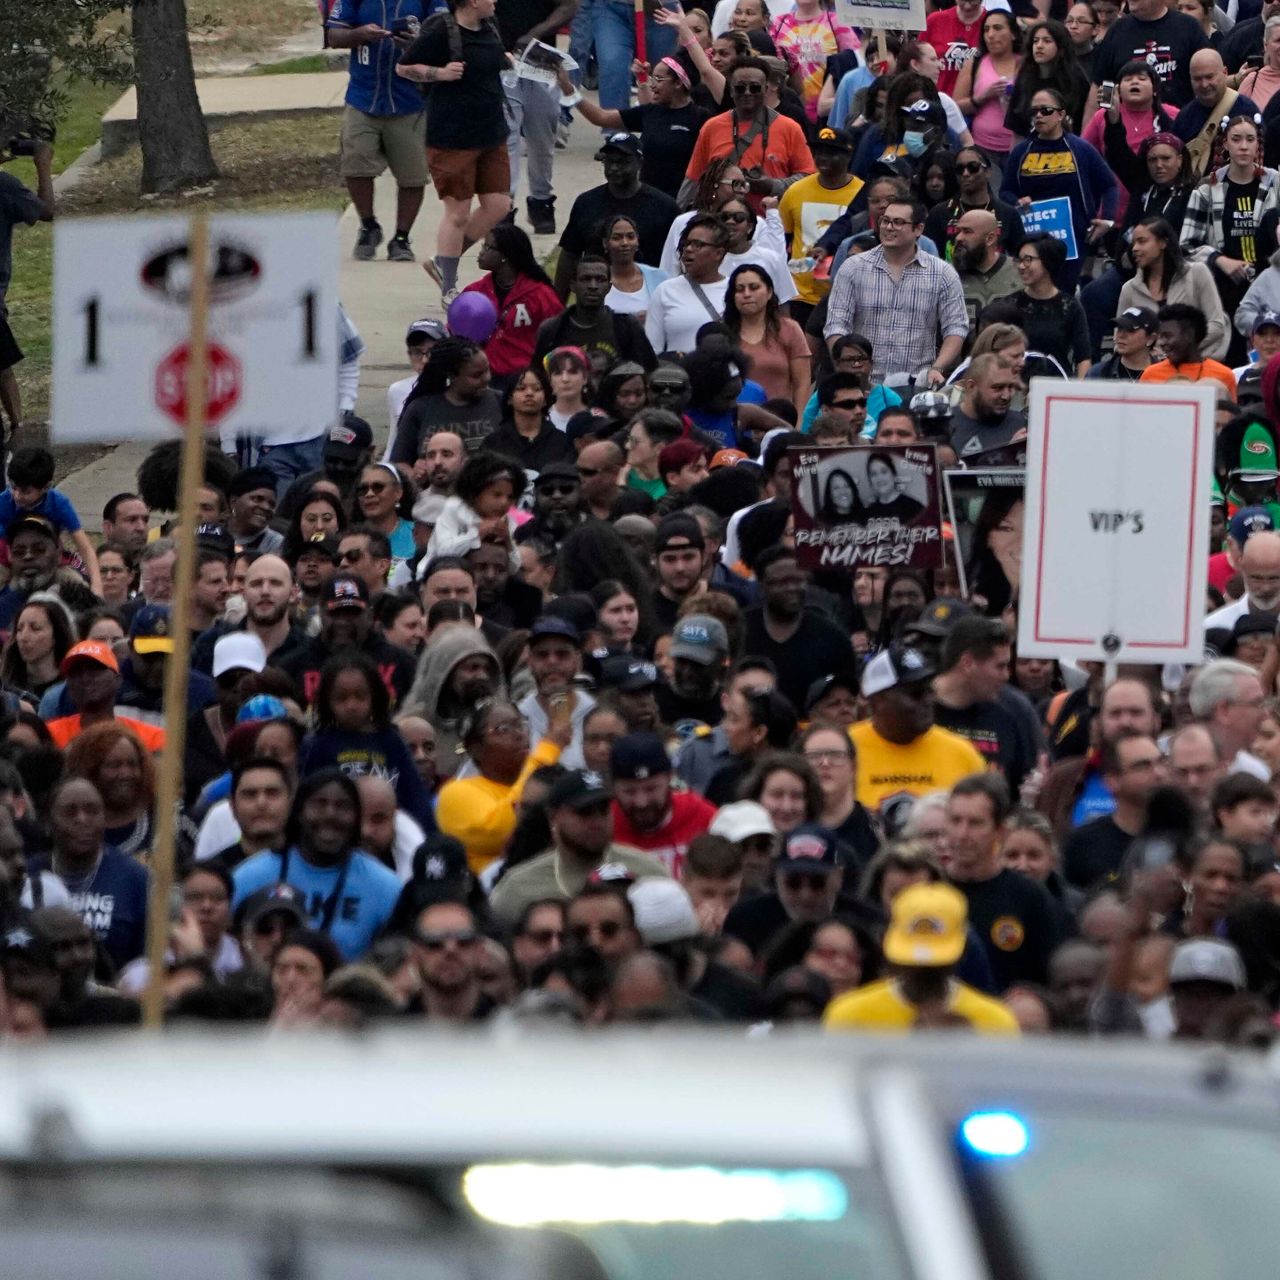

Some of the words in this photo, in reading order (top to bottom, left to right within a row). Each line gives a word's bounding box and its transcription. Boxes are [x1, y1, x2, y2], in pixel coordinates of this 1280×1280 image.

[358, 45, 369, 65] 18
[1233, 211, 1254, 219] BLACK
[514, 303, 532, 327] A
[85, 296, 101, 366] 1
[302, 290, 318, 359] 1
[157, 371, 239, 404] SOP
[800, 454, 818, 466] Eva
[905, 448, 929, 462] Irma
[1089, 511, 1143, 534] VIP'S
[796, 527, 890, 546] REMEMBER
[893, 525, 938, 540] THEIR
[820, 542, 914, 566] NAMES!
